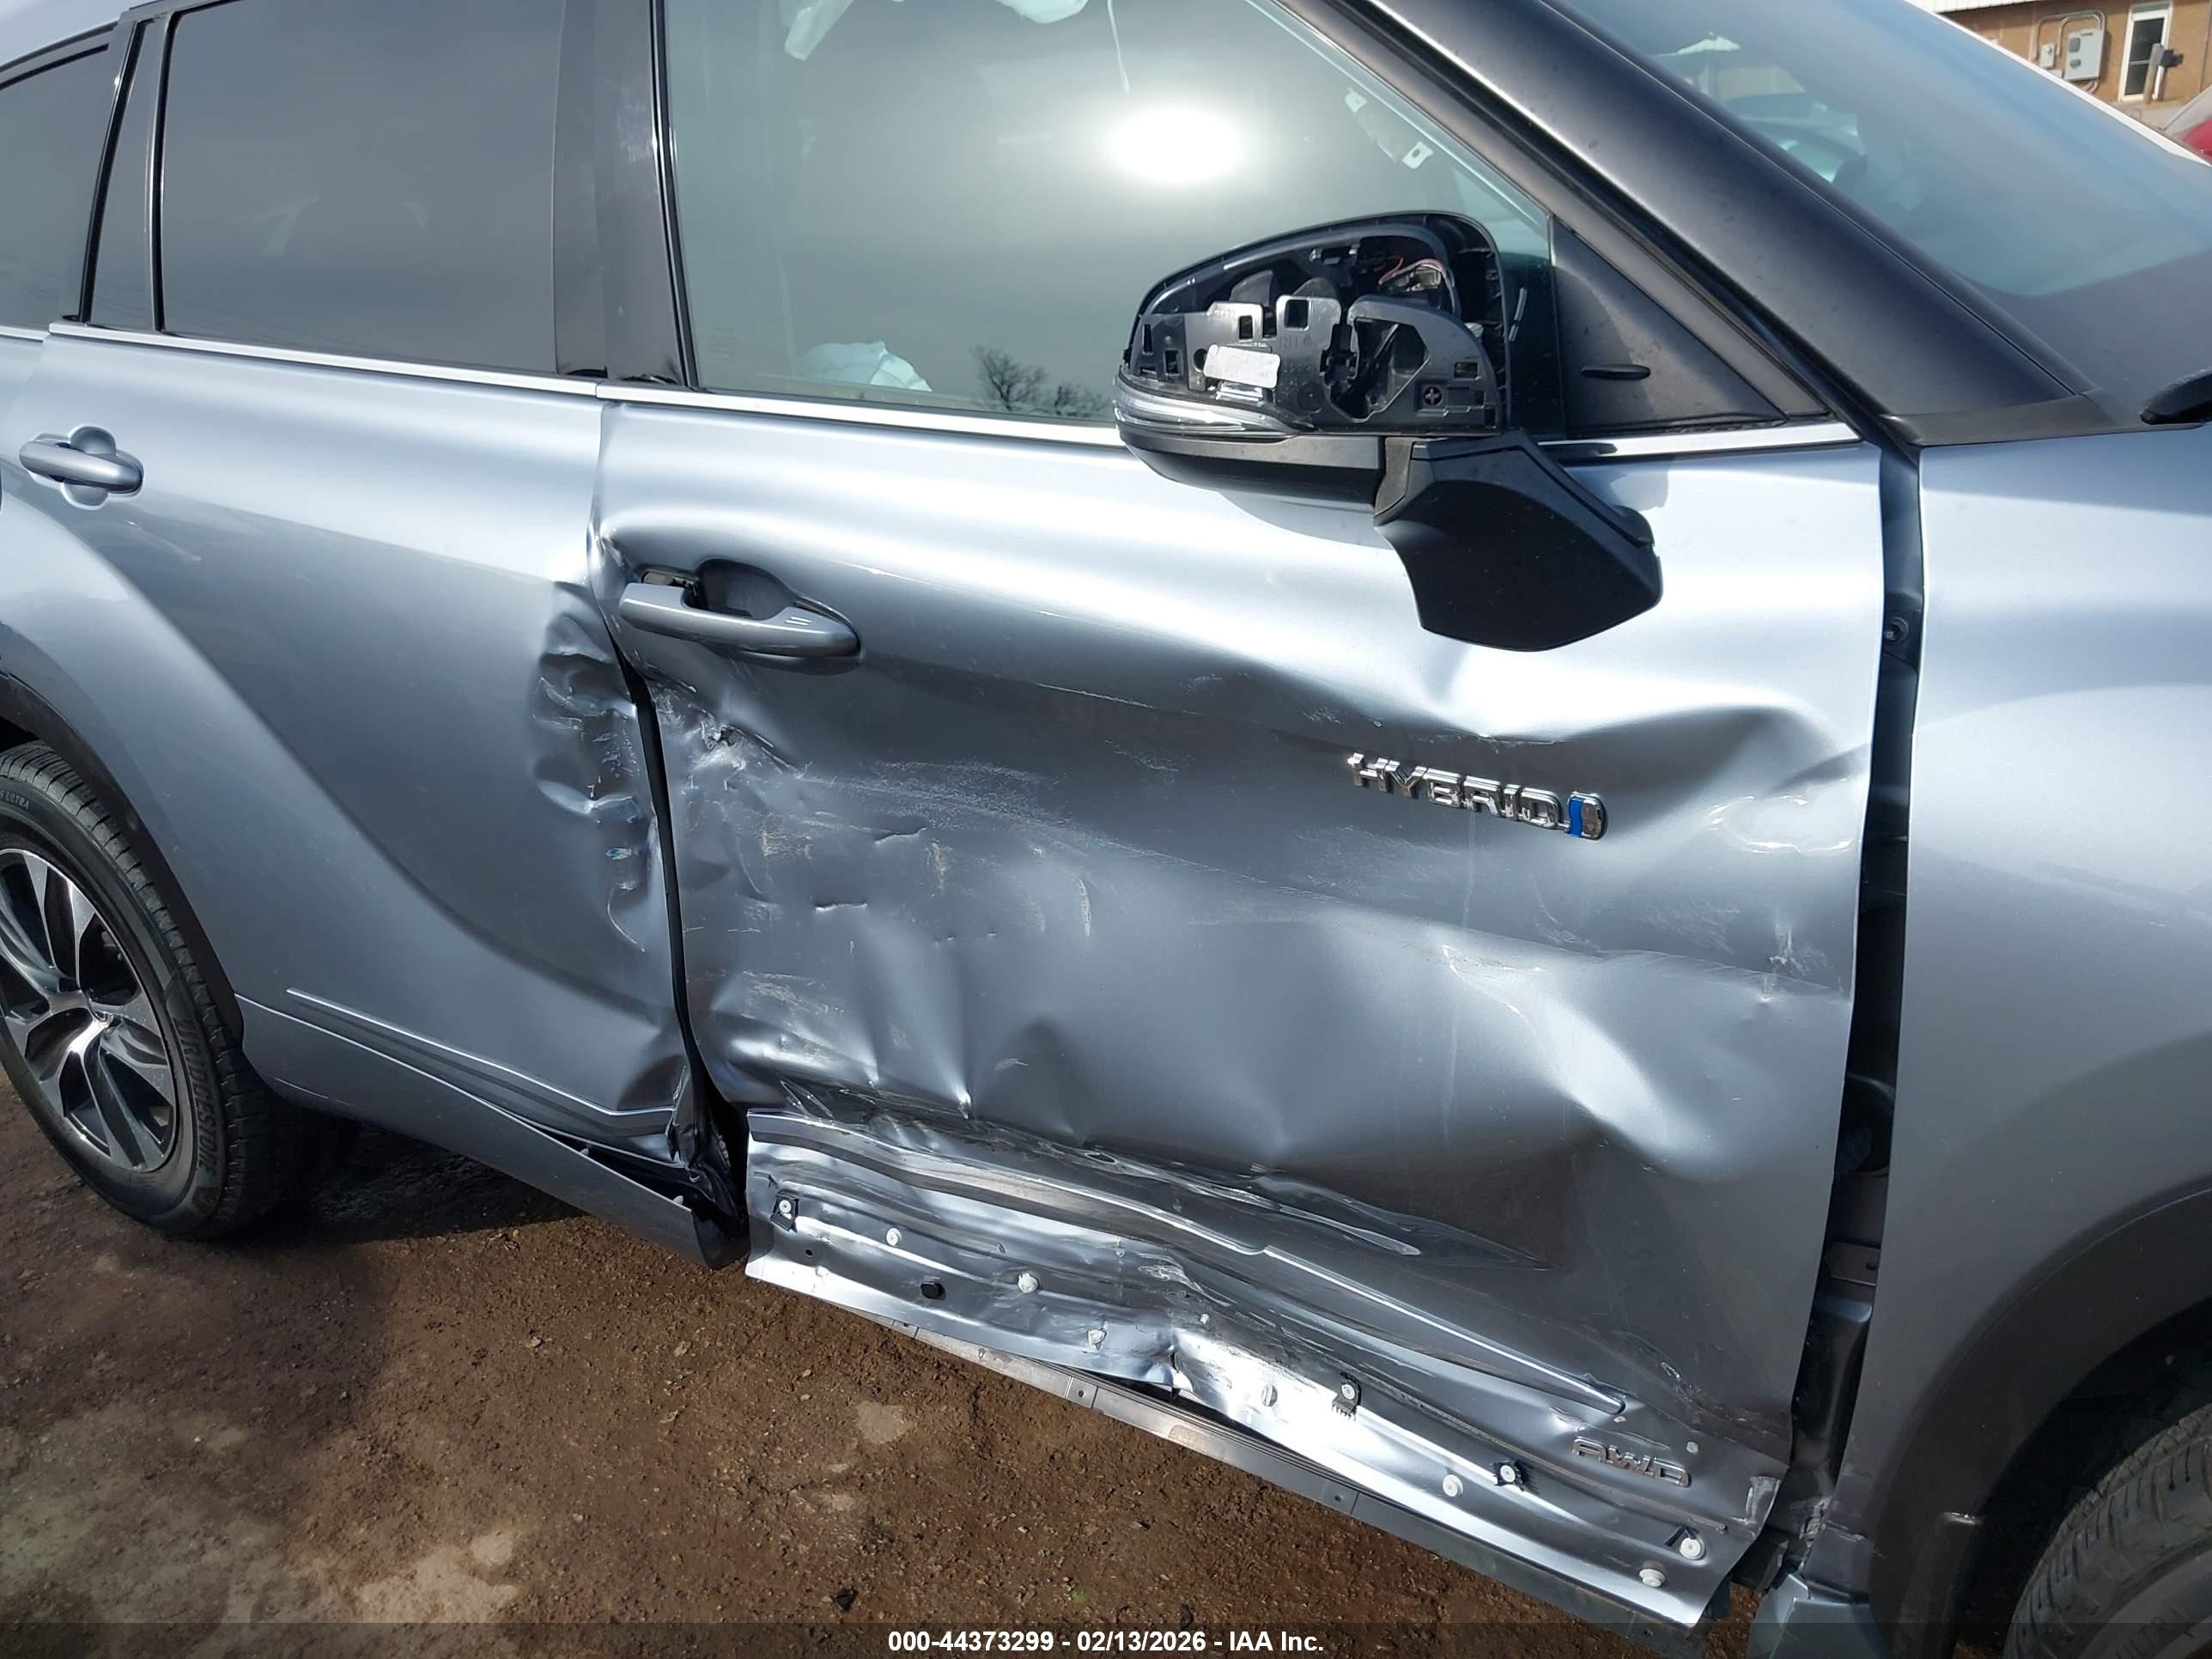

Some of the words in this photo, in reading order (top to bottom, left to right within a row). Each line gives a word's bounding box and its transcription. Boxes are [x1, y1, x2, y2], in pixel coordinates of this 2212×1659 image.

[1347, 752, 1562, 830] HYBRID
[173, 1017, 219, 1176] BRIDGESTONE
[1571, 1436, 1692, 1488] AWD
